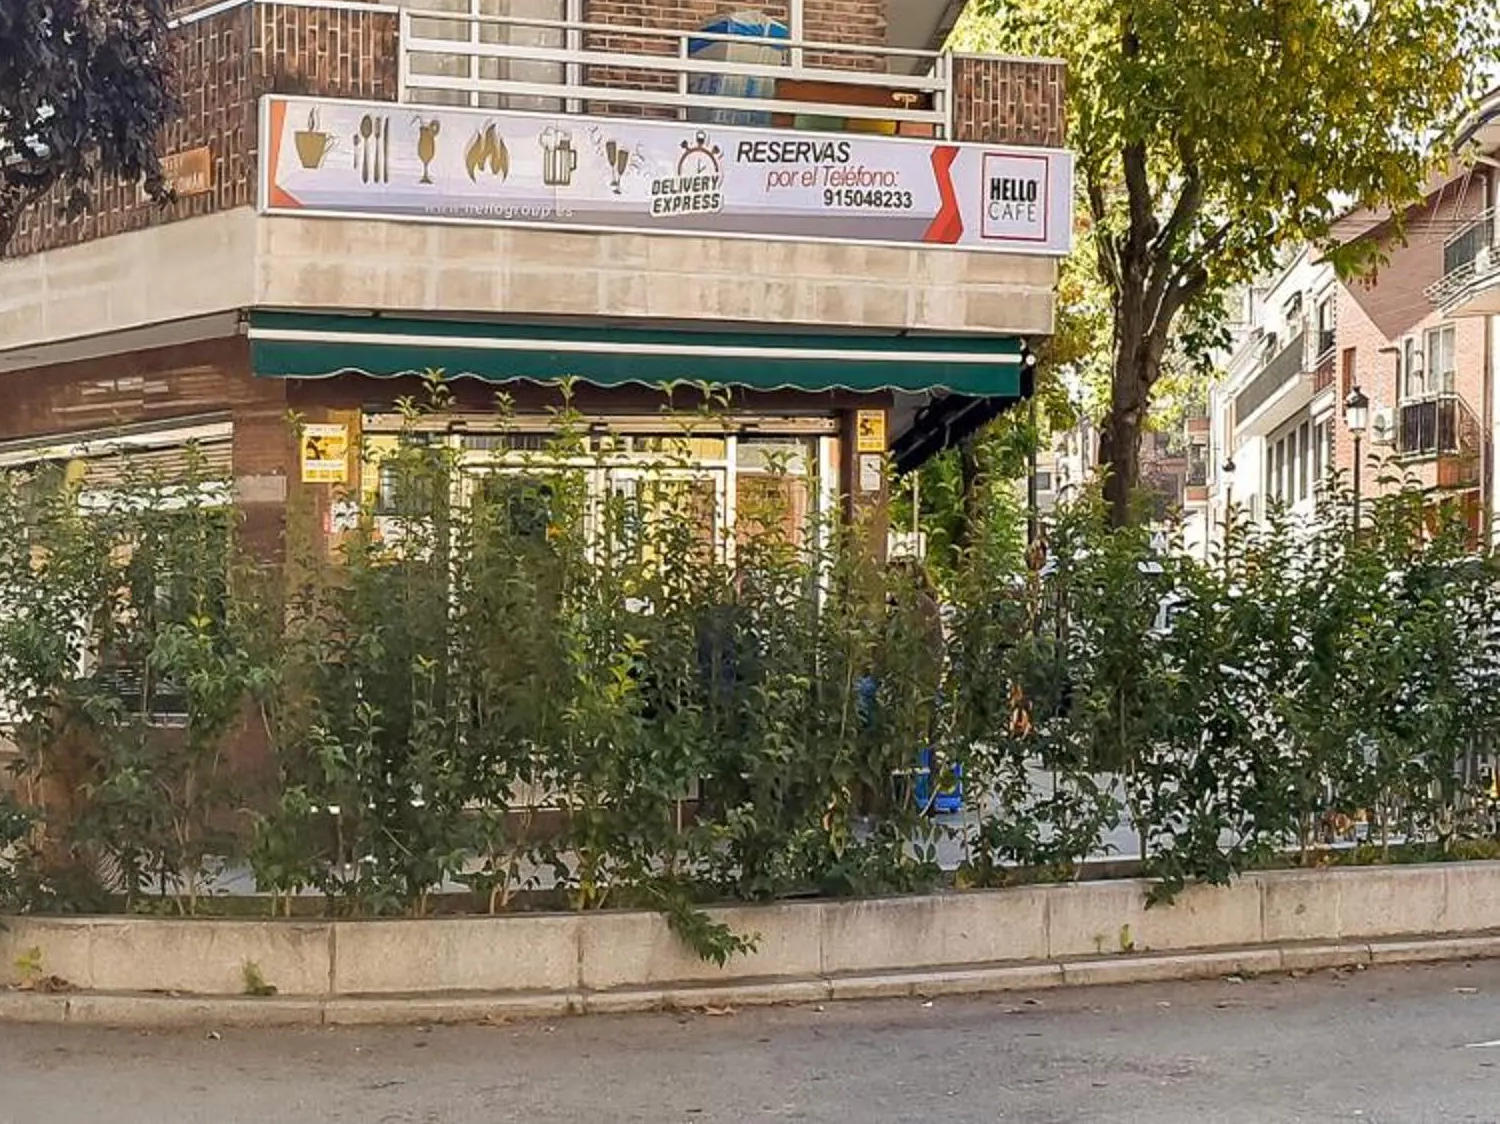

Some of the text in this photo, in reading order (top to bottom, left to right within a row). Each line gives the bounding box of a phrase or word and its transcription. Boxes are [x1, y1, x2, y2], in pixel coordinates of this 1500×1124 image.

[737, 141, 851, 164] RESERVAS
[651, 175, 719, 195] DELIVERY
[766, 165, 900, 192] por el Teléfono:
[823, 189, 913, 209] 915048233
[990, 177, 1038, 202] HELLO
[653, 193, 720, 214] EXPRESS
[988, 202, 1037, 223] CAFE
